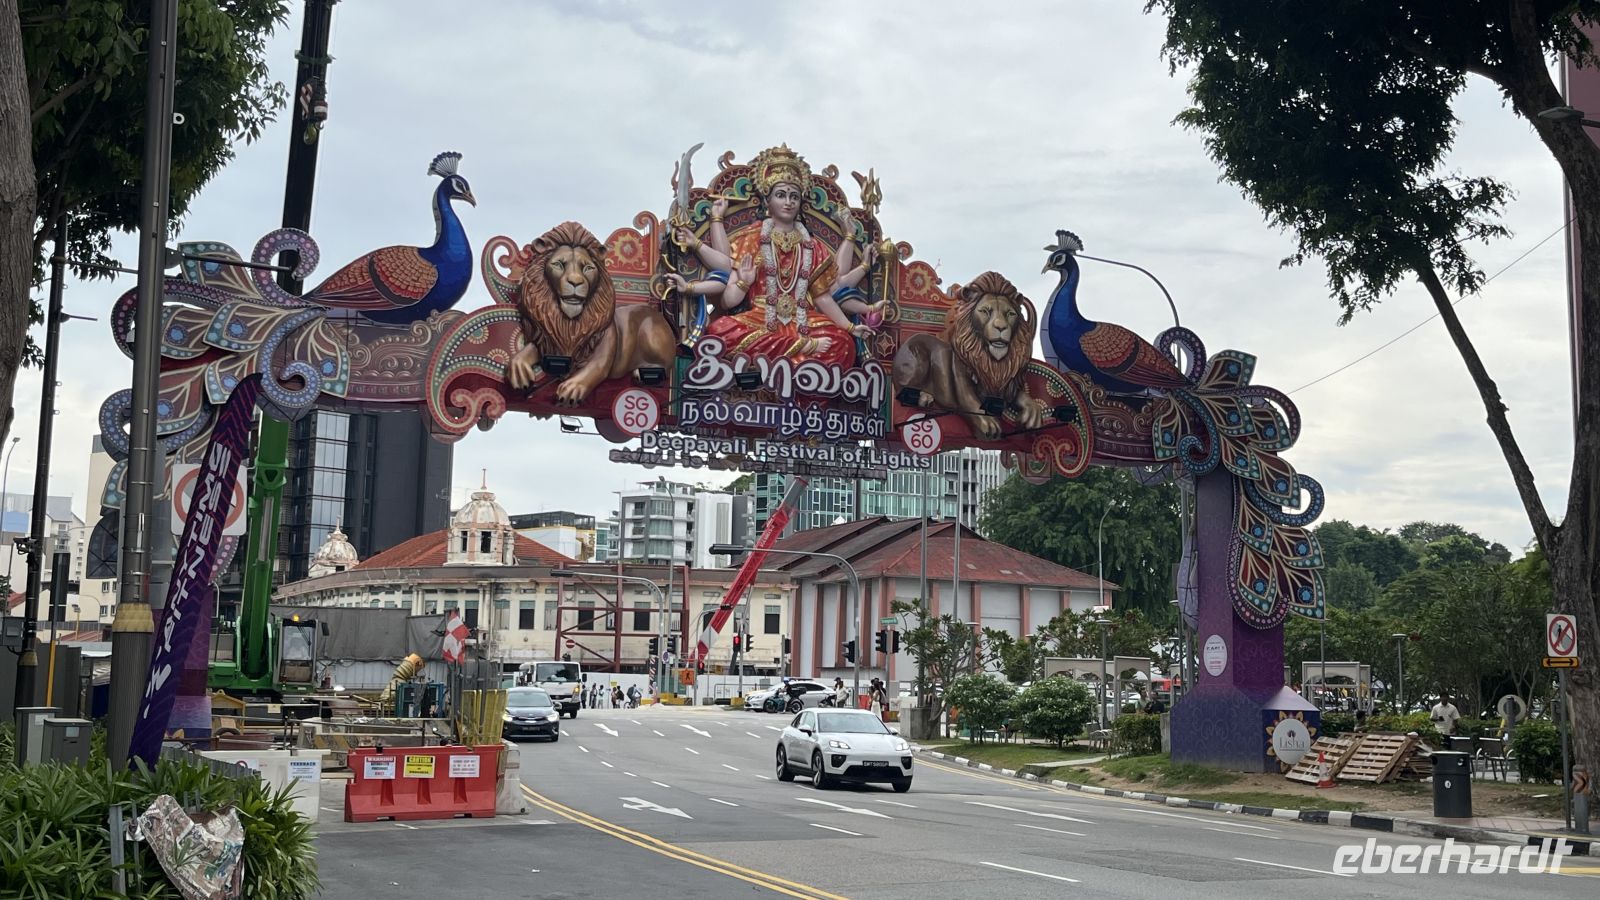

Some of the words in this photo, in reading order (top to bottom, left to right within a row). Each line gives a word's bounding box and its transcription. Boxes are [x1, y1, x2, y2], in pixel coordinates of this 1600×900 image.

[624, 395, 649, 411] SG
[623, 411, 648, 428] 60
[911, 420, 933, 432] SG
[911, 433, 933, 449] 60
[643, 431, 746, 454] Deepavali
[755, 440, 835, 461] Festival
[843, 449, 863, 463] of
[870, 449, 931, 469] Lights
